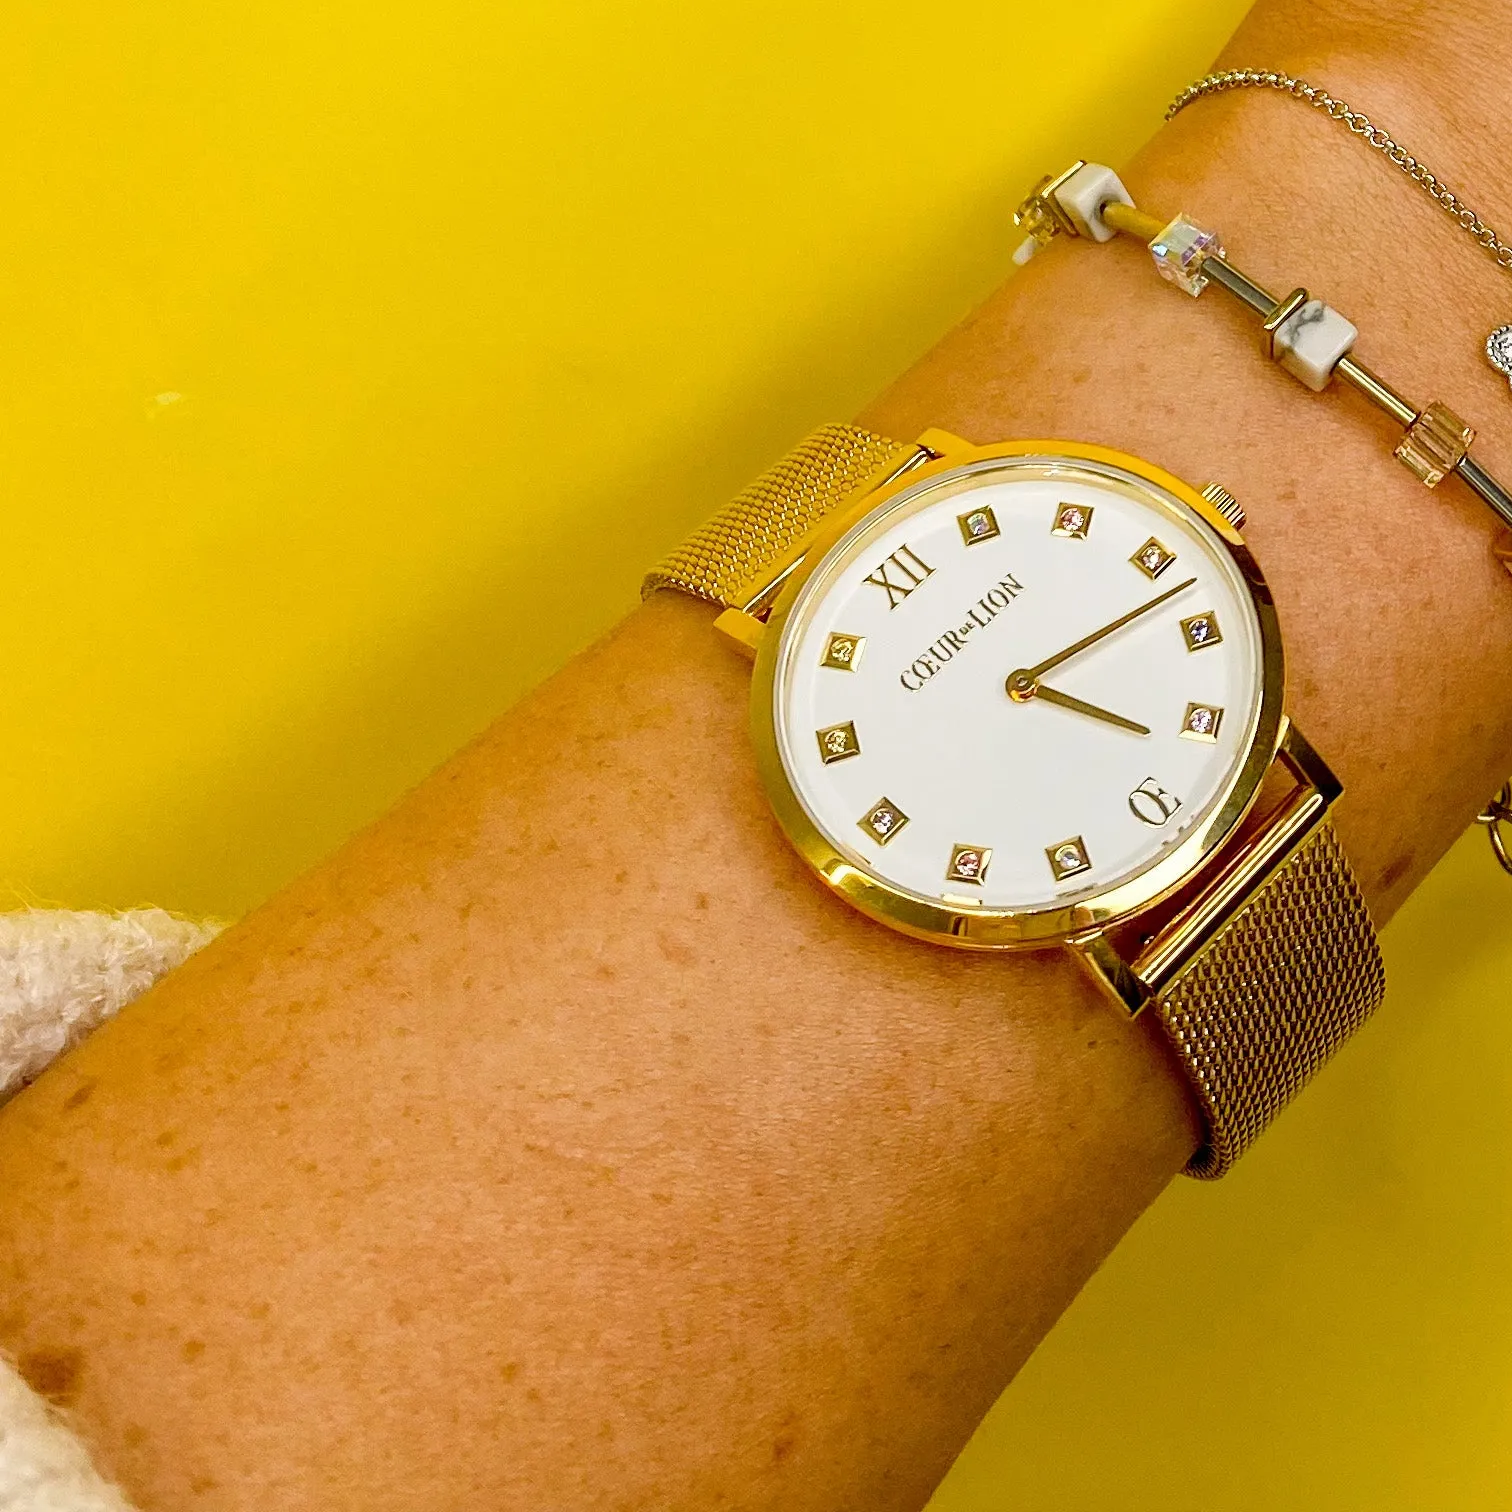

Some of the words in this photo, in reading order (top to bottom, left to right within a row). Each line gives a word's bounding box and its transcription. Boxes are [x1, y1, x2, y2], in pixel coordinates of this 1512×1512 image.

[862, 543, 936, 610] XII
[900, 630, 968, 692] CŒUR
[966, 573, 1025, 628] LION
